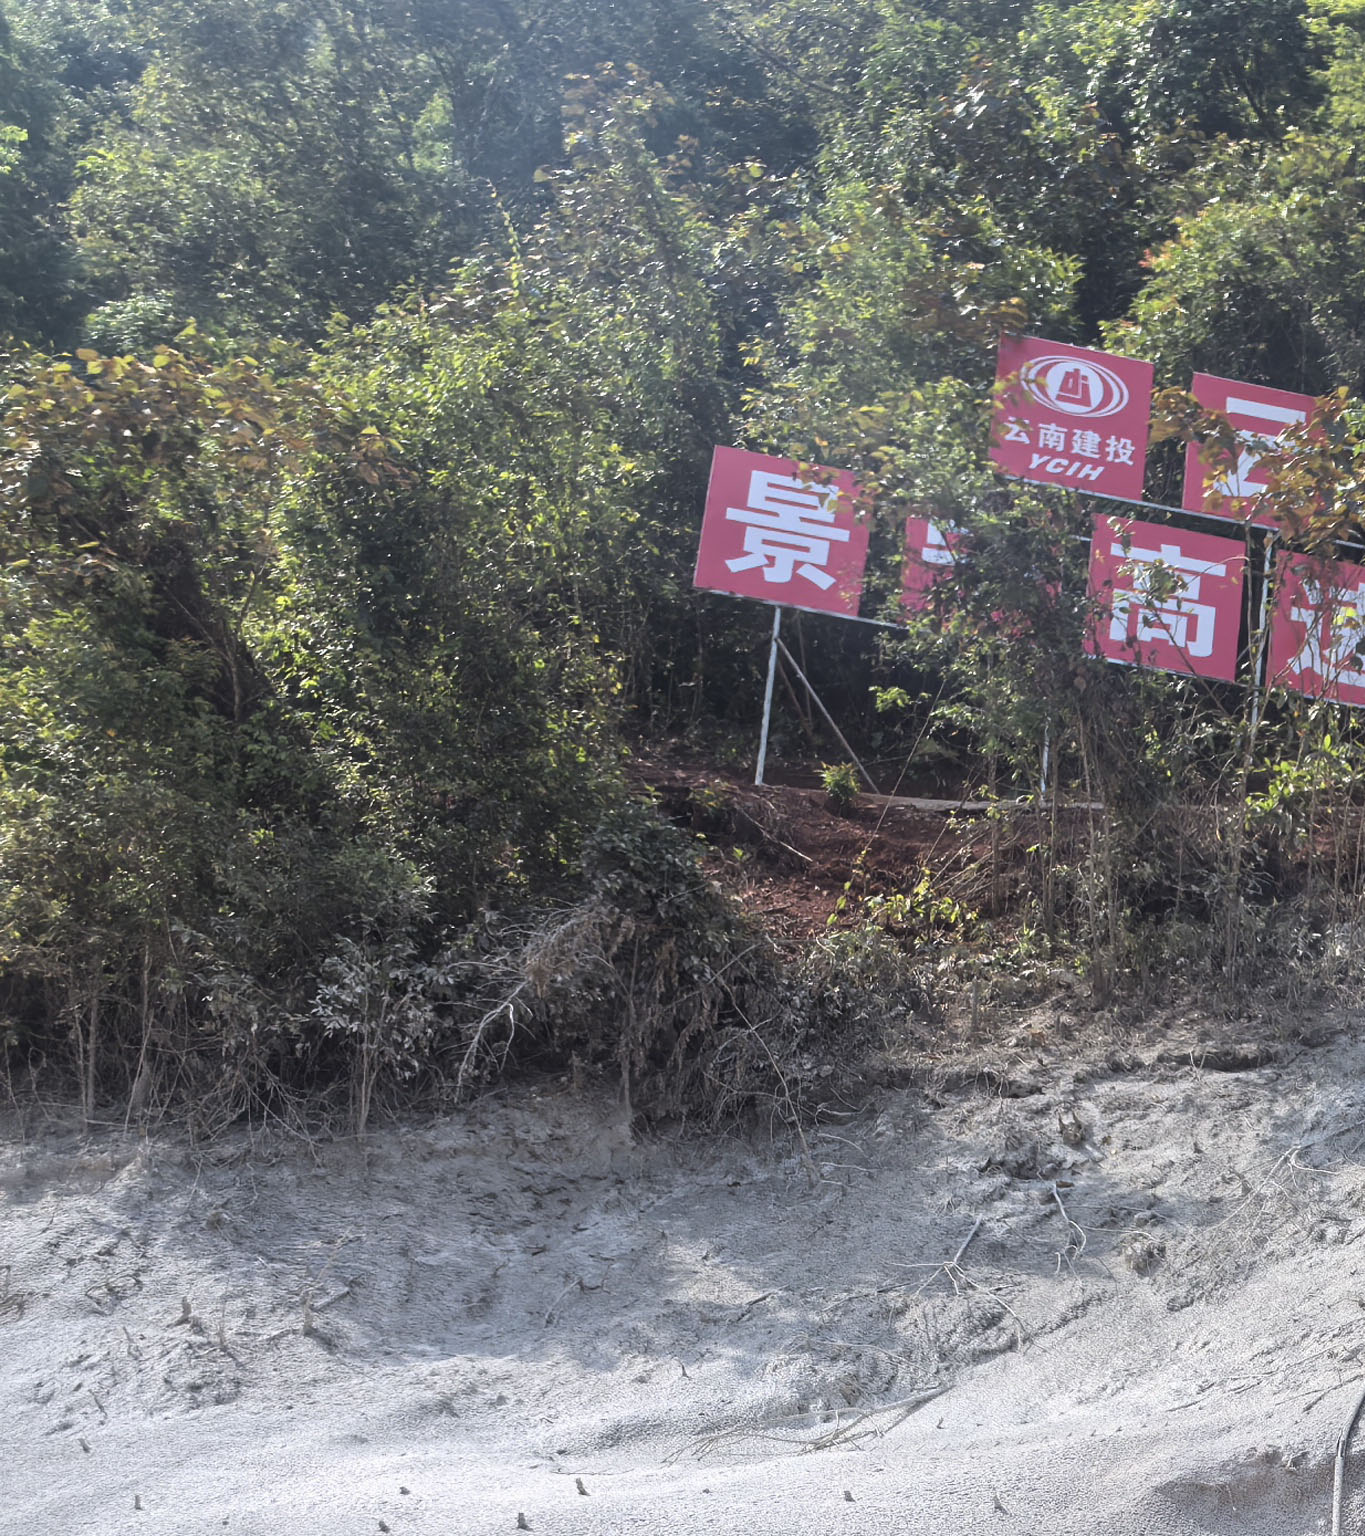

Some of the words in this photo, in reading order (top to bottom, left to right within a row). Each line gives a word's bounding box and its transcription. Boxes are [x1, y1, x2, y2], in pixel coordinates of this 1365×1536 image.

[1003, 415, 1136, 466] 云南建投
[1028, 453, 1105, 481] YCIH
